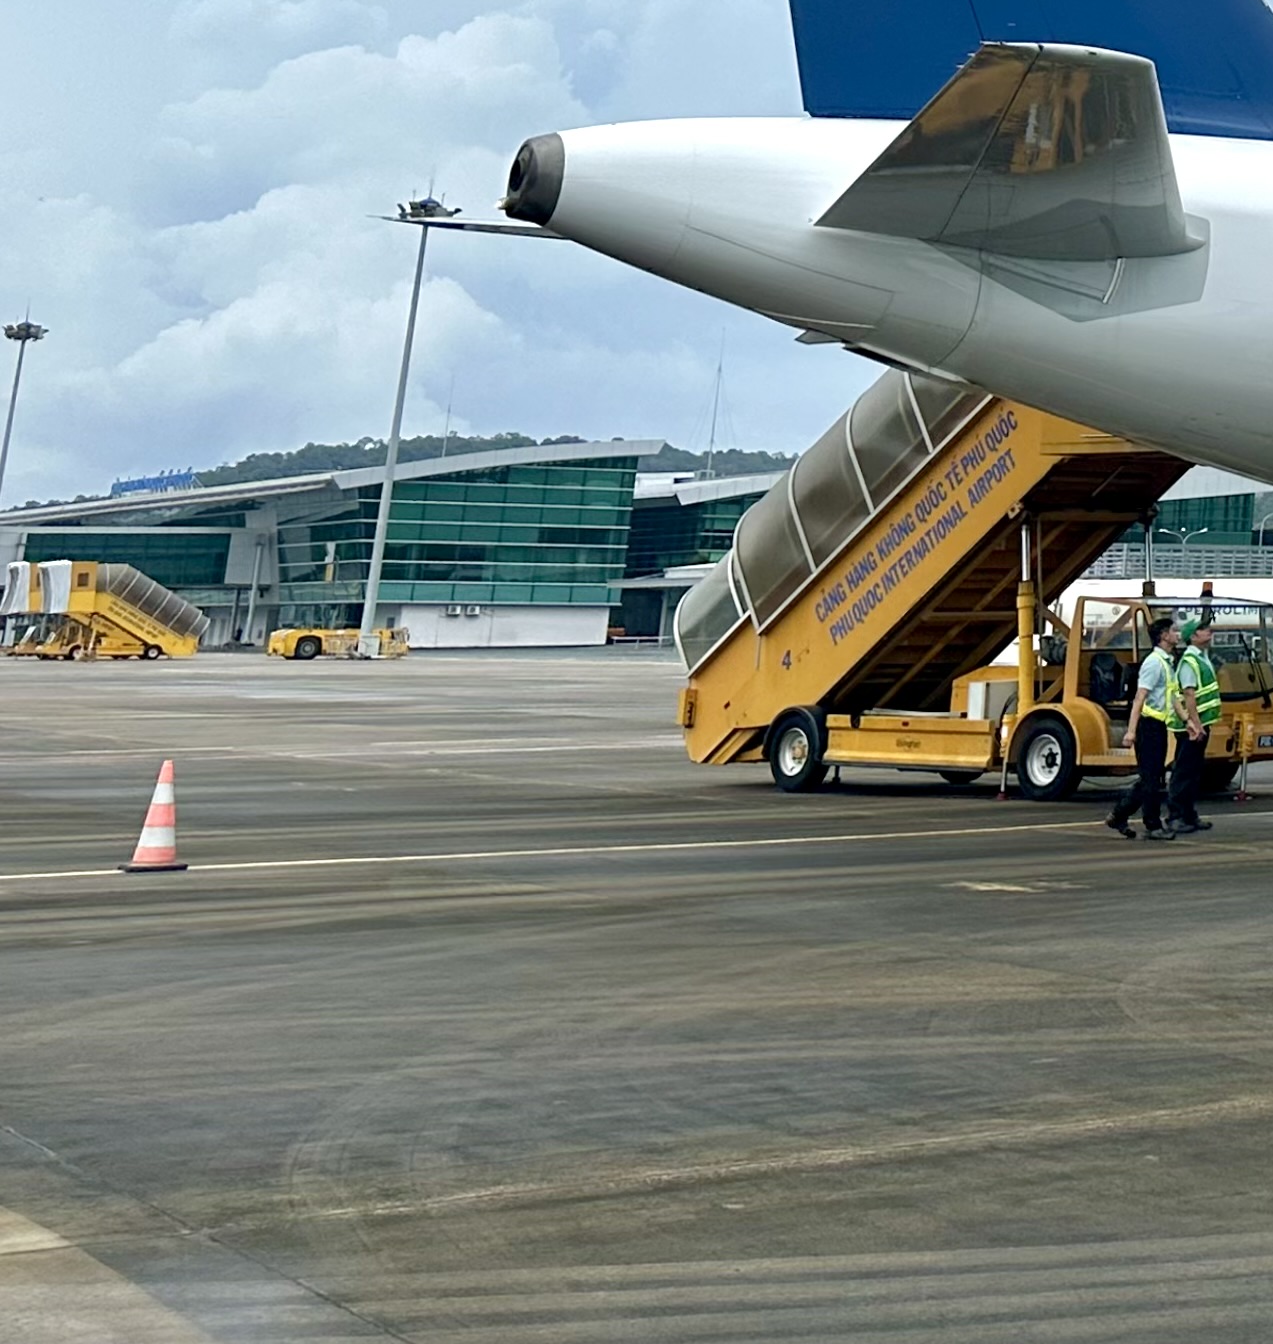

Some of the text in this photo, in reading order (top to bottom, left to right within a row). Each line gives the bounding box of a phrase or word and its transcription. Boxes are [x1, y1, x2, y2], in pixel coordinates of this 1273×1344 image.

[875, 514, 917, 562] KHÔNG
[880, 500, 969, 595] INTERNATIONAL
[967, 447, 1016, 509] AIRPORT
[780, 649, 792, 670] 4
